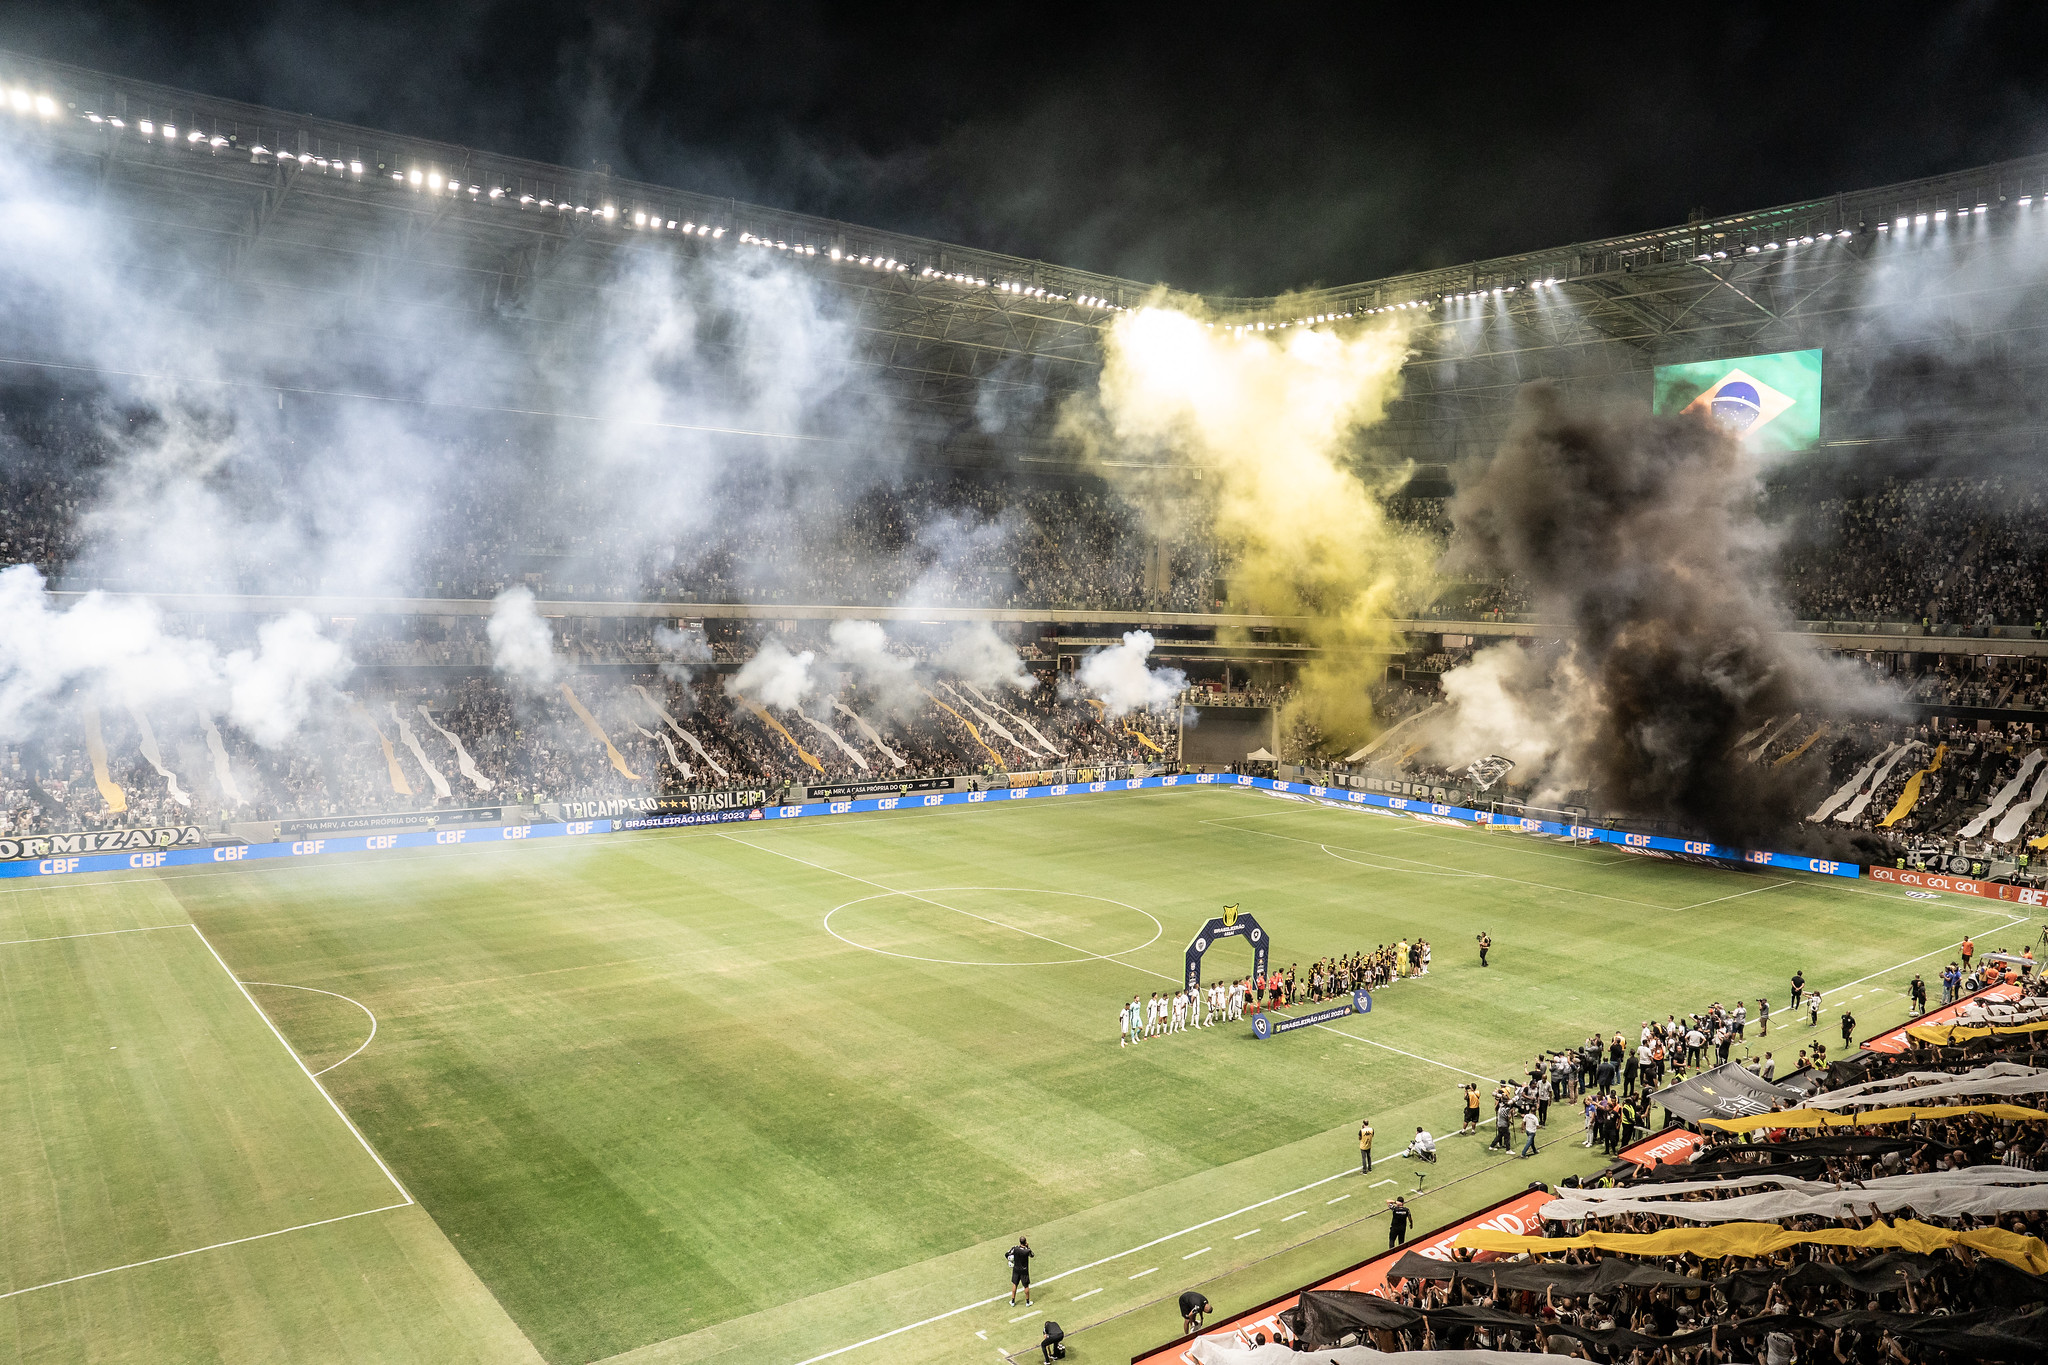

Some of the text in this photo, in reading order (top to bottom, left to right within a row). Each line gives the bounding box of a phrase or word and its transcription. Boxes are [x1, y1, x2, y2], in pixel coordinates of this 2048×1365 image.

[1126, 779, 1143, 790] CBF
[1162, 776, 1178, 786] CBF
[1196, 774, 1214, 783] CBF
[1238, 775, 1253, 786] CBF
[1050, 785, 1068, 796] CBF
[1089, 782, 1107, 793] CBF
[1272, 781, 1290, 791] CBF
[1309, 786, 1327, 797] CBF
[967, 791, 987, 803] CBF
[1010, 788, 1028, 799] CBF
[1348, 791, 1367, 803] CBF
[878, 798, 899, 810] CBF
[924, 795, 944, 806] CBF
[1388, 797, 1408, 809] CBF
[562, 797, 659, 819] TRICAMPEÃO
[780, 805, 802, 818] CBF
[830, 802, 852, 814] CBF
[1431, 803, 1451, 816] CBF
[340, 820, 347, 828] A
[347, 819, 369, 827] CASA
[370, 816, 404, 826] PRÓPRIA
[625, 814, 695, 828] BRASILEIRÃO
[696, 813, 718, 825] ASSAÍ
[722, 811, 745, 820] 2023
[1520, 818, 1542, 832] CBF
[503, 826, 531, 839] CBF
[565, 821, 594, 835] CBF
[1570, 826, 1594, 839] CBF
[366, 835, 398, 850] CBF
[436, 830, 466, 845] CBF
[1625, 833, 1651, 847] CBF
[213, 846, 249, 861] CBF
[292, 840, 325, 855] CBF
[1684, 841, 1711, 855] CBF
[129, 852, 167, 868] CBF
[1745, 849, 1773, 864] CBF
[39, 858, 80, 875] CBF
[1809, 858, 1840, 874] CBF
[1873, 869, 1895, 881] GOL
[1900, 873, 1922, 885] GOL
[1927, 877, 1950, 889] GOL
[1955, 881, 1979, 894] GOL
